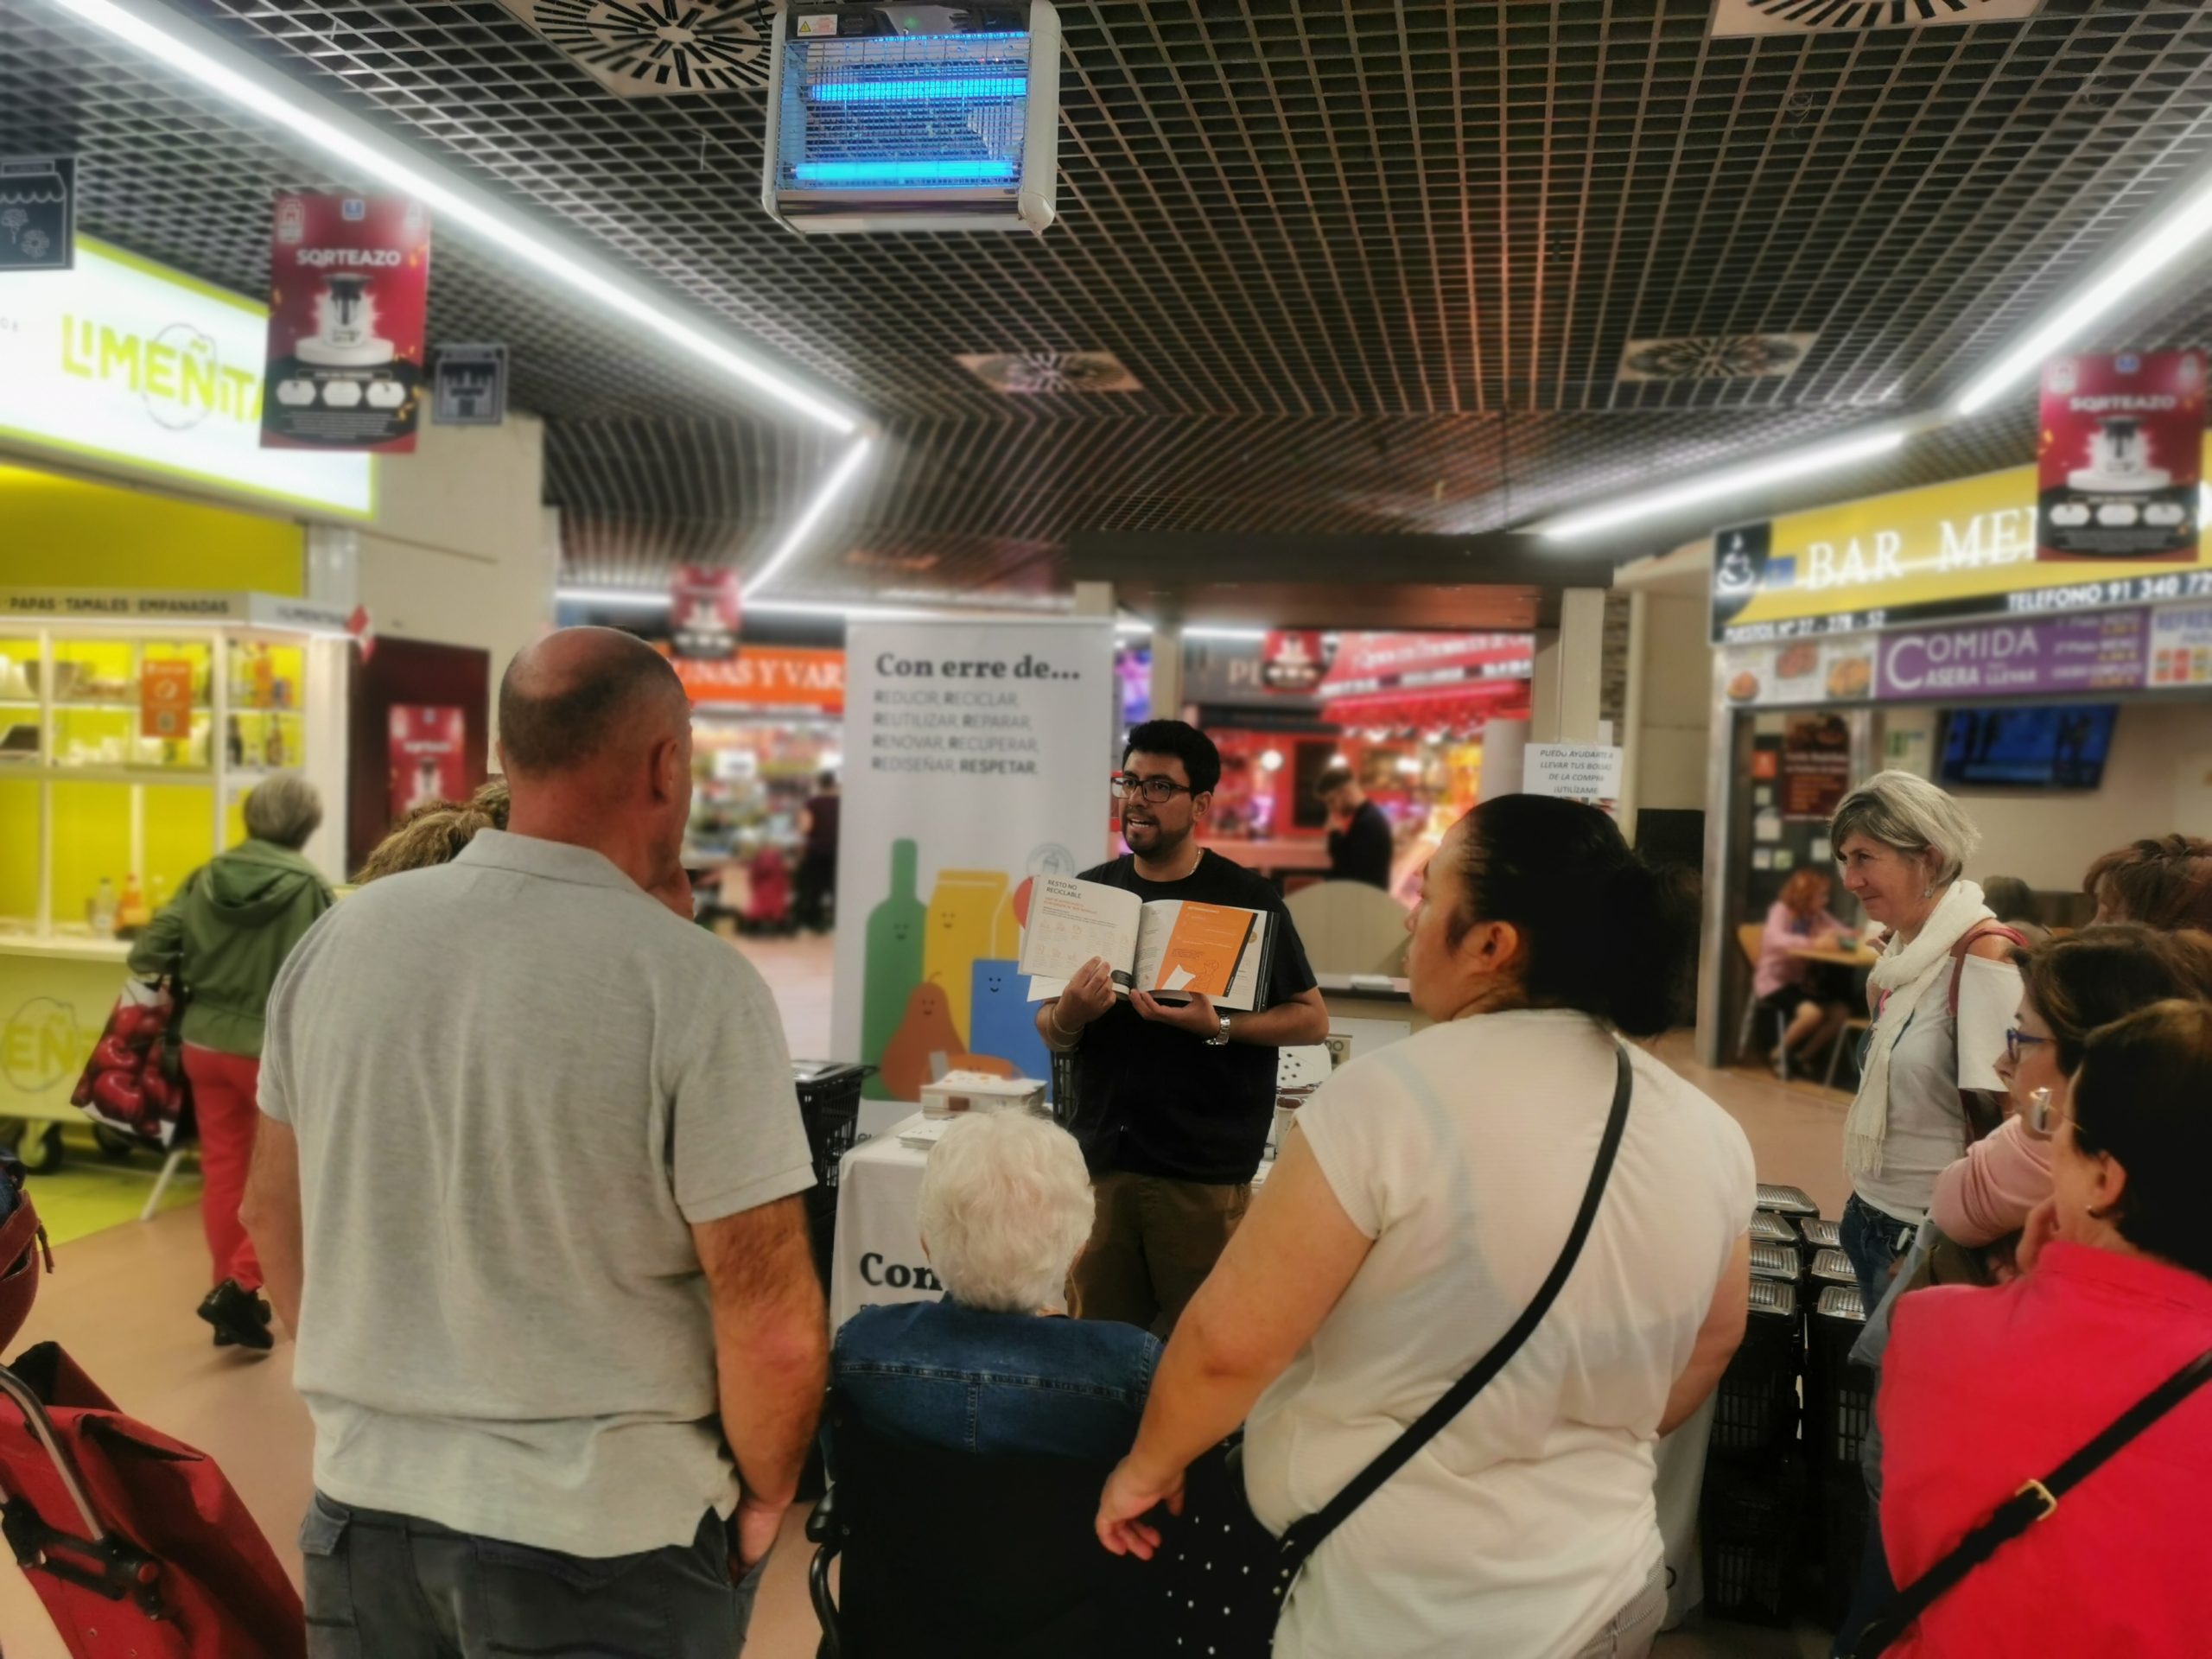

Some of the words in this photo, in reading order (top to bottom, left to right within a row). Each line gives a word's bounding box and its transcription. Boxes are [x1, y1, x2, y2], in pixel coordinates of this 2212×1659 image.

[1806, 530, 1904, 590] BAR
[10, 597, 56, 613] PAPAS
[65, 597, 129, 613] TAMALES
[138, 598, 229, 614] EMPANADAS
[875, 652, 934, 677] Con
[941, 660, 1007, 678] erre
[1014, 654, 1081, 680] de...
[1046, 887, 1082, 899] RECICLABLE
[1048, 880, 1068, 889] RESTO
[860, 1251, 943, 1292] Con
